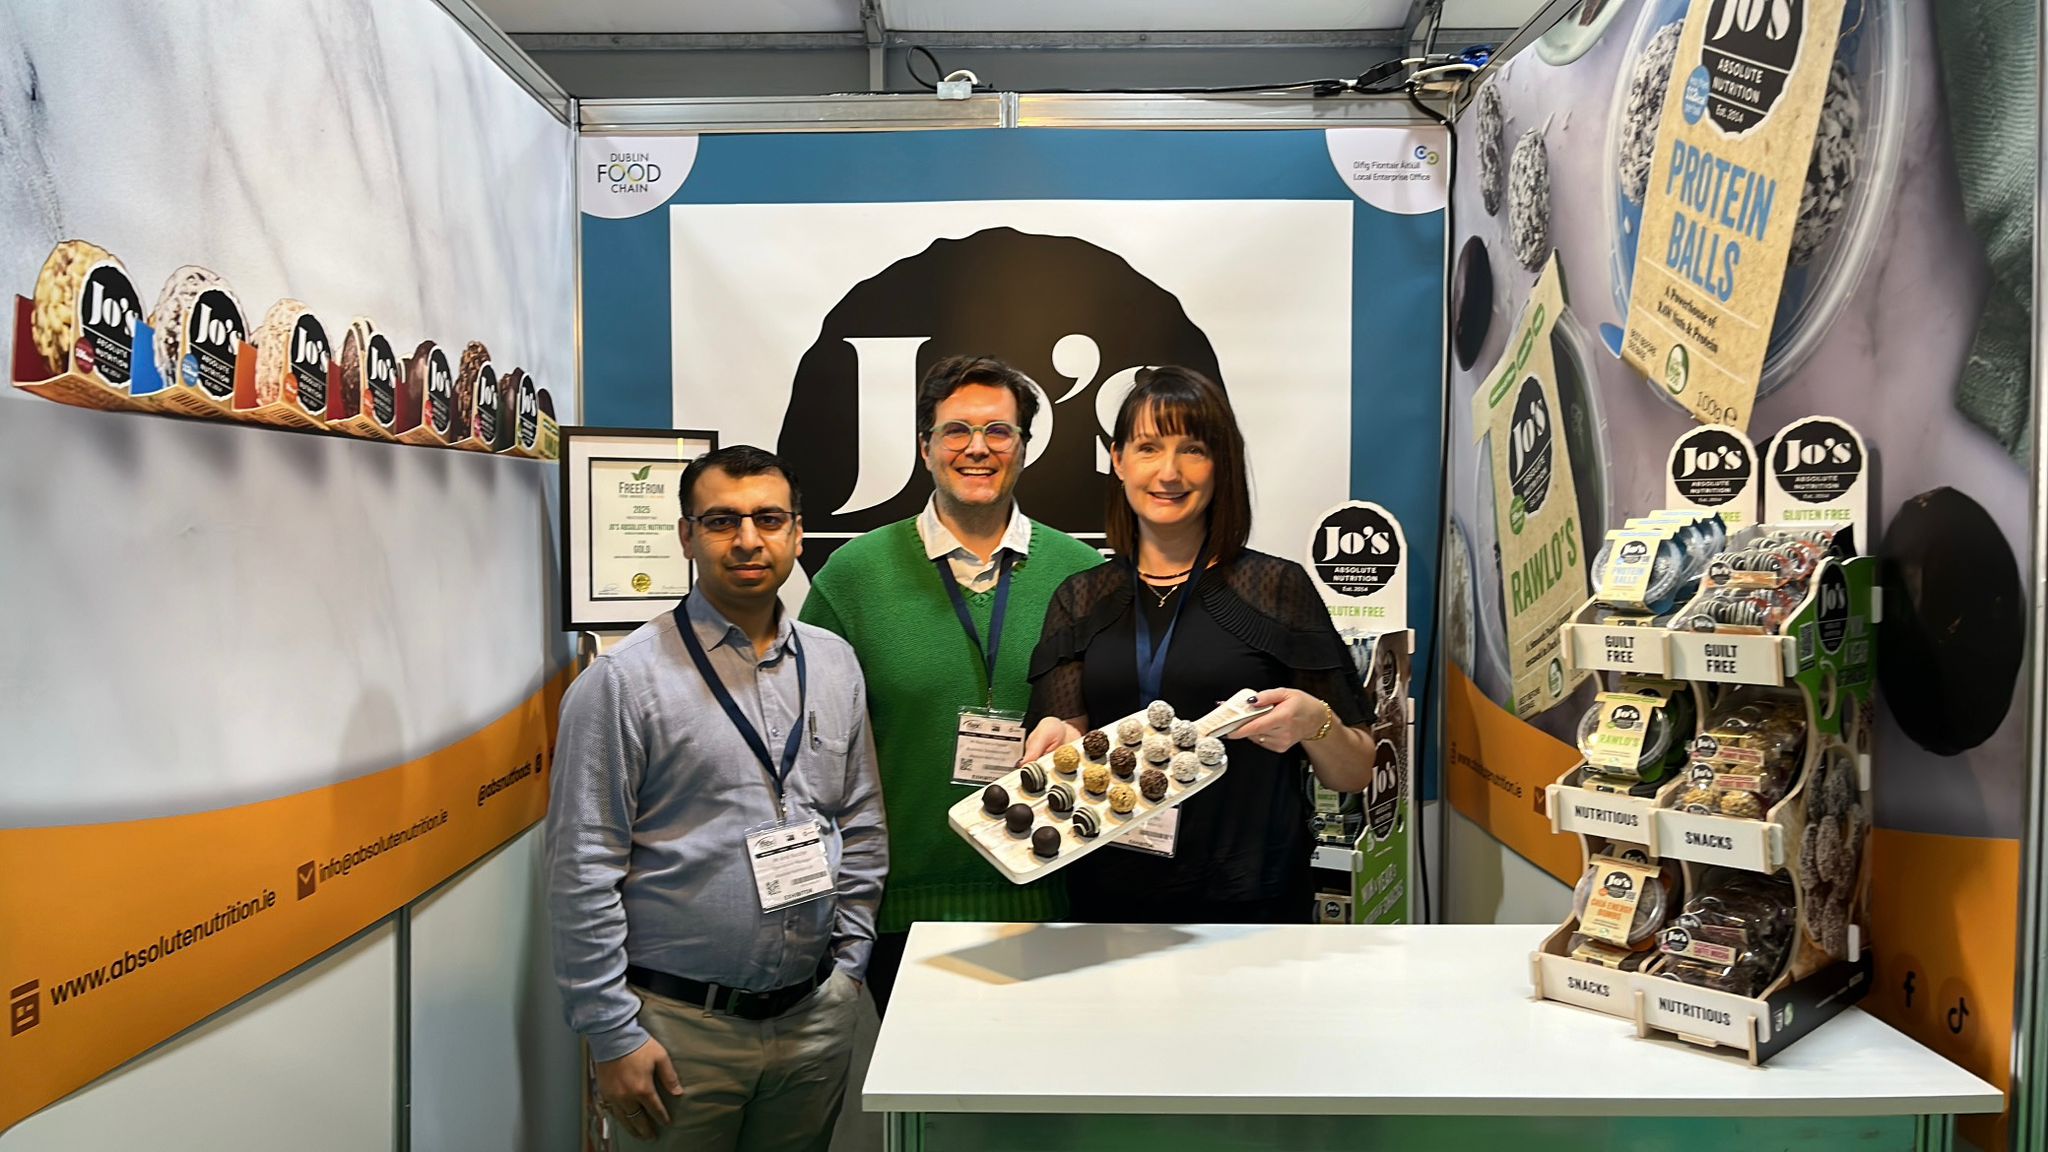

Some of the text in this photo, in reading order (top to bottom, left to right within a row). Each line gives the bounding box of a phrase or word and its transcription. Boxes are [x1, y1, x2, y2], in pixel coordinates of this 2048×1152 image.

[1712, 0, 1794, 41] Jos
[1717, 58, 1765, 84] ABSOLUTE
[1711, 76, 1761, 104] NUTRITION
[610, 153, 649, 162] DUBLIN
[597, 163, 661, 183] FOOD
[1353, 173, 1431, 182] Local Enterprise Office
[611, 184, 648, 193] CHAIN
[1666, 139, 1776, 241] PROTEIN
[1666, 211, 1741, 302] BALLS
[88, 281, 139, 337] Jo's
[195, 303, 242, 355] Jo's
[295, 327, 329, 373] Jo's
[1513, 399, 1546, 477] Jo's
[1681, 446, 1742, 478] Jo's
[1783, 438, 1852, 473] Jo's
[1783, 508, 1850, 521] GLUTEN FREE
[1321, 526, 1390, 561] Jo's
[1334, 566, 1377, 574] ABSOLUTE
[1511, 517, 1577, 617] RAWLO'S
[1327, 605, 1385, 618] GLUTEN FREE
[1821, 582, 1846, 618] Jo's
[1605, 635, 1634, 649] GUILT
[1704, 643, 1738, 658] GUILT
[1607, 650, 1634, 663] FREE
[1706, 659, 1737, 674] FREE
[1614, 708, 1640, 721] Jo's
[1371, 761, 1397, 805] Jo's
[1575, 805, 1638, 827] NUTRITIOUS
[319, 808, 449, 884] info@absolutenutrition.ie
[1685, 832, 1733, 850] SNACKS
[1606, 874, 1631, 888] Jo's
[50, 888, 276, 1006] www.absolutenutrition.ie
[1567, 976, 1610, 997] SNACKS
[1658, 997, 1731, 1026] NUTRITIOUS
